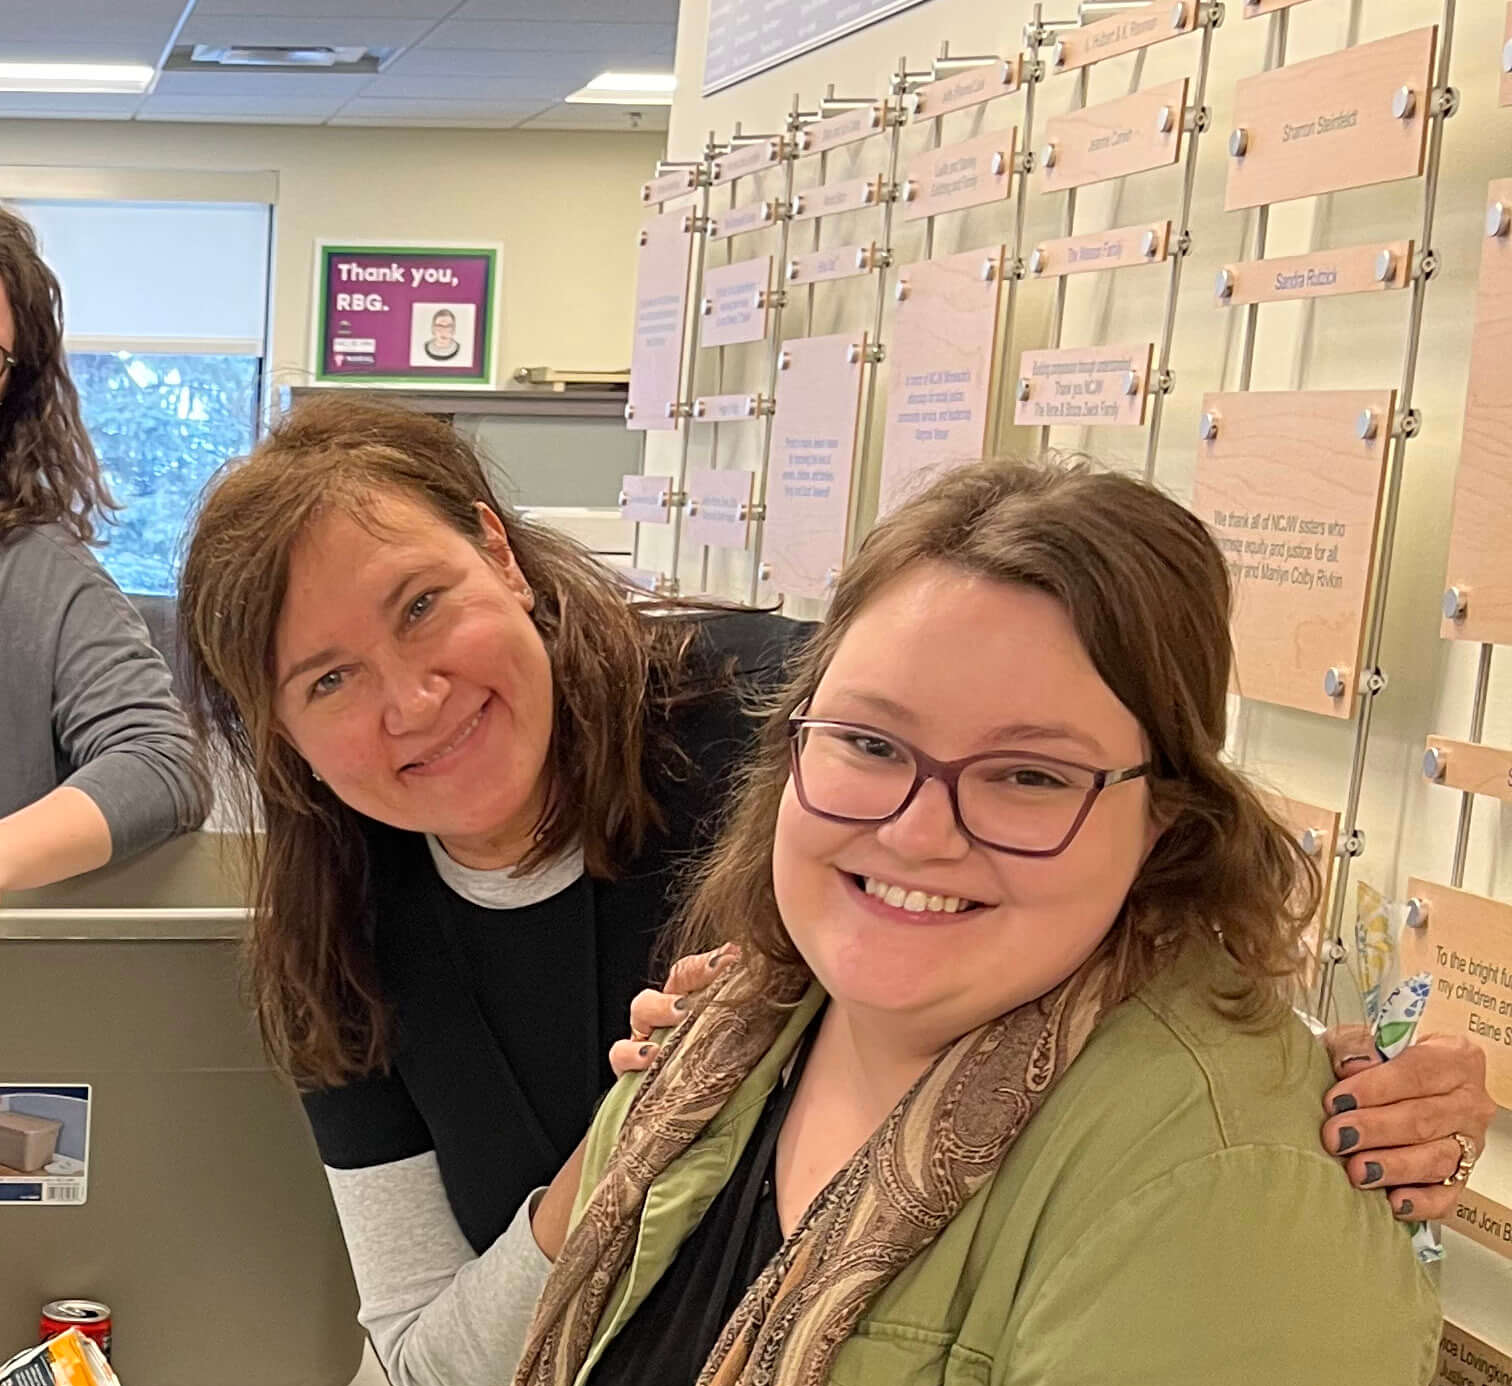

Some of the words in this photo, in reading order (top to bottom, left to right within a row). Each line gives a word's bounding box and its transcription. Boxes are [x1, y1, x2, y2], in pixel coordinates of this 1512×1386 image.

[337, 263, 405, 283] Thank
[410, 268, 459, 288] you,
[336, 293, 390, 311] RBG.
[1228, 510, 1249, 529] thank
[1299, 518, 1325, 536] sisters
[1327, 519, 1346, 537] who
[1268, 541, 1285, 559] and
[1285, 542, 1312, 563] justice
[1313, 543, 1325, 561] for
[1244, 563, 1259, 580] and
[1290, 566, 1315, 591] Colby
[1436, 944, 1448, 966] To
[1450, 951, 1467, 973] the
[1468, 957, 1499, 985] bright
[1437, 978, 1454, 1001] my
[1455, 984, 1497, 1012] children
[1467, 1012, 1502, 1042] Elaine
[1456, 1203, 1478, 1225] and
